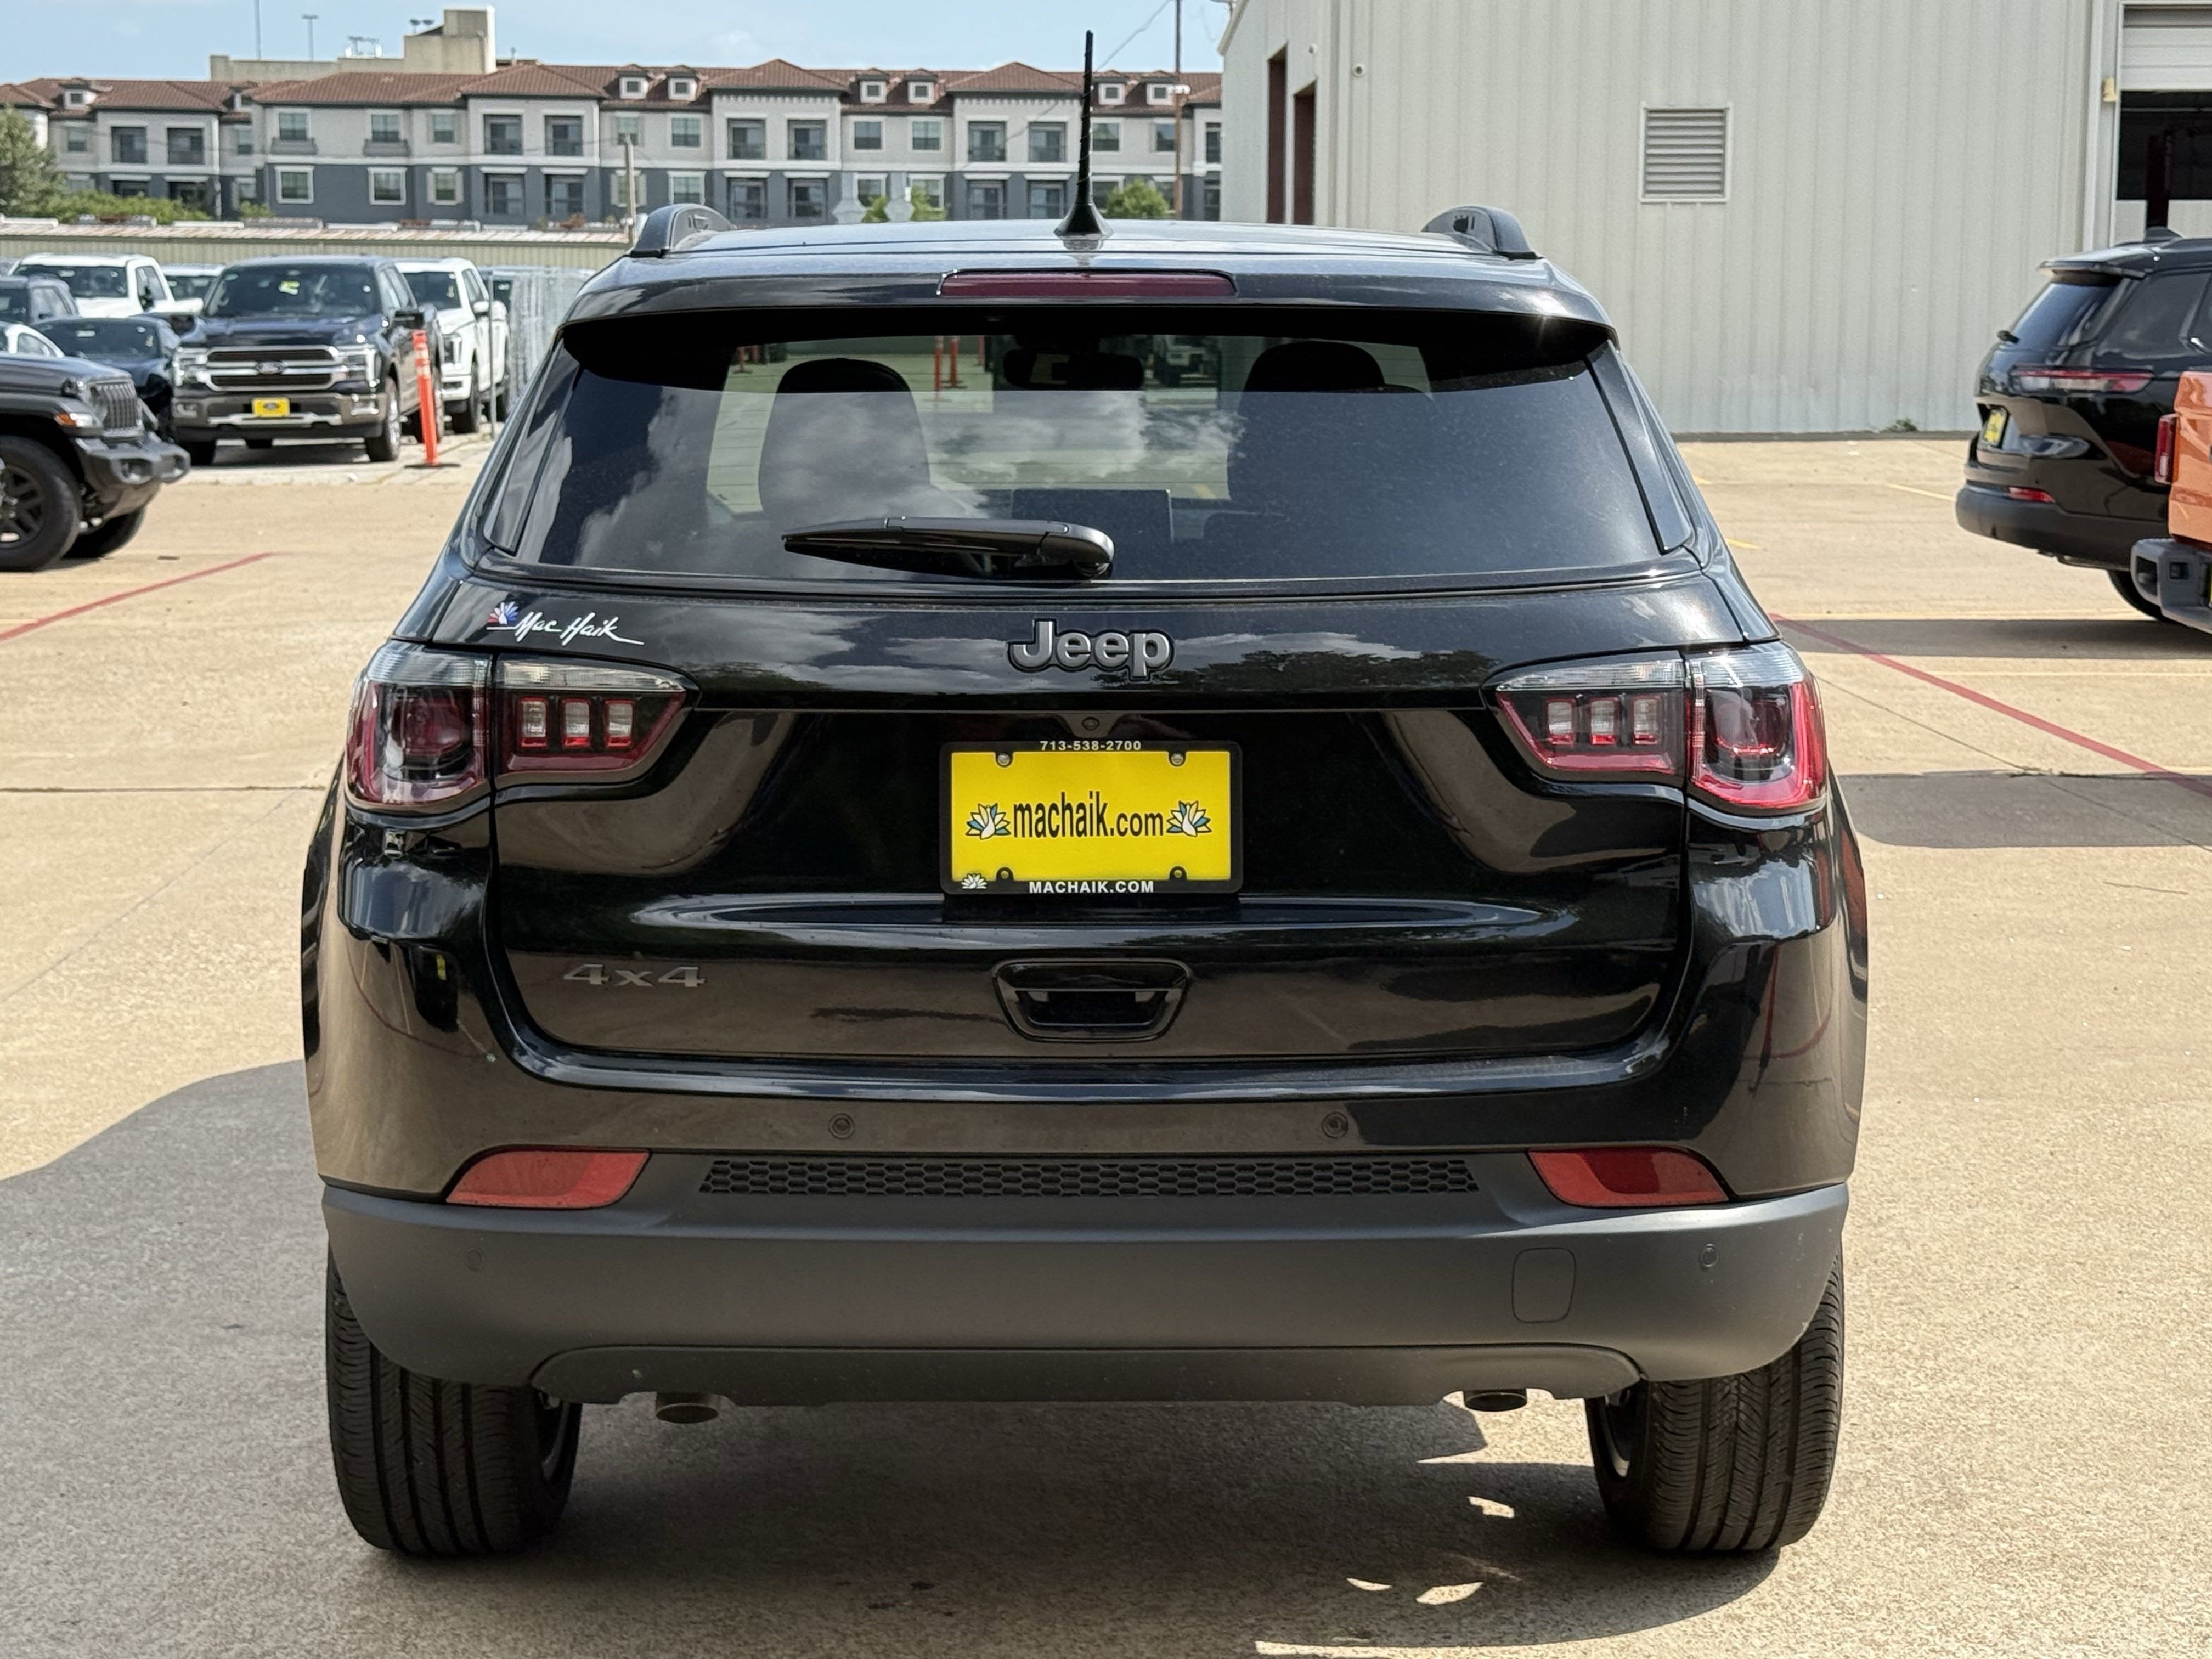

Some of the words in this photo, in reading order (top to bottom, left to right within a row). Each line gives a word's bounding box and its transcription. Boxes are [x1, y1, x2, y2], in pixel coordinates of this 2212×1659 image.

[486, 612, 562, 642] Mac
[560, 612, 645, 646] Haik
[1010, 619, 1172, 678] Jeep
[1040, 740, 1142, 752] 713-538-2700
[1013, 790, 1165, 838] machaik.com
[1029, 880, 1154, 894] MACHAIK.COM
[563, 963, 708, 988] 4x4
